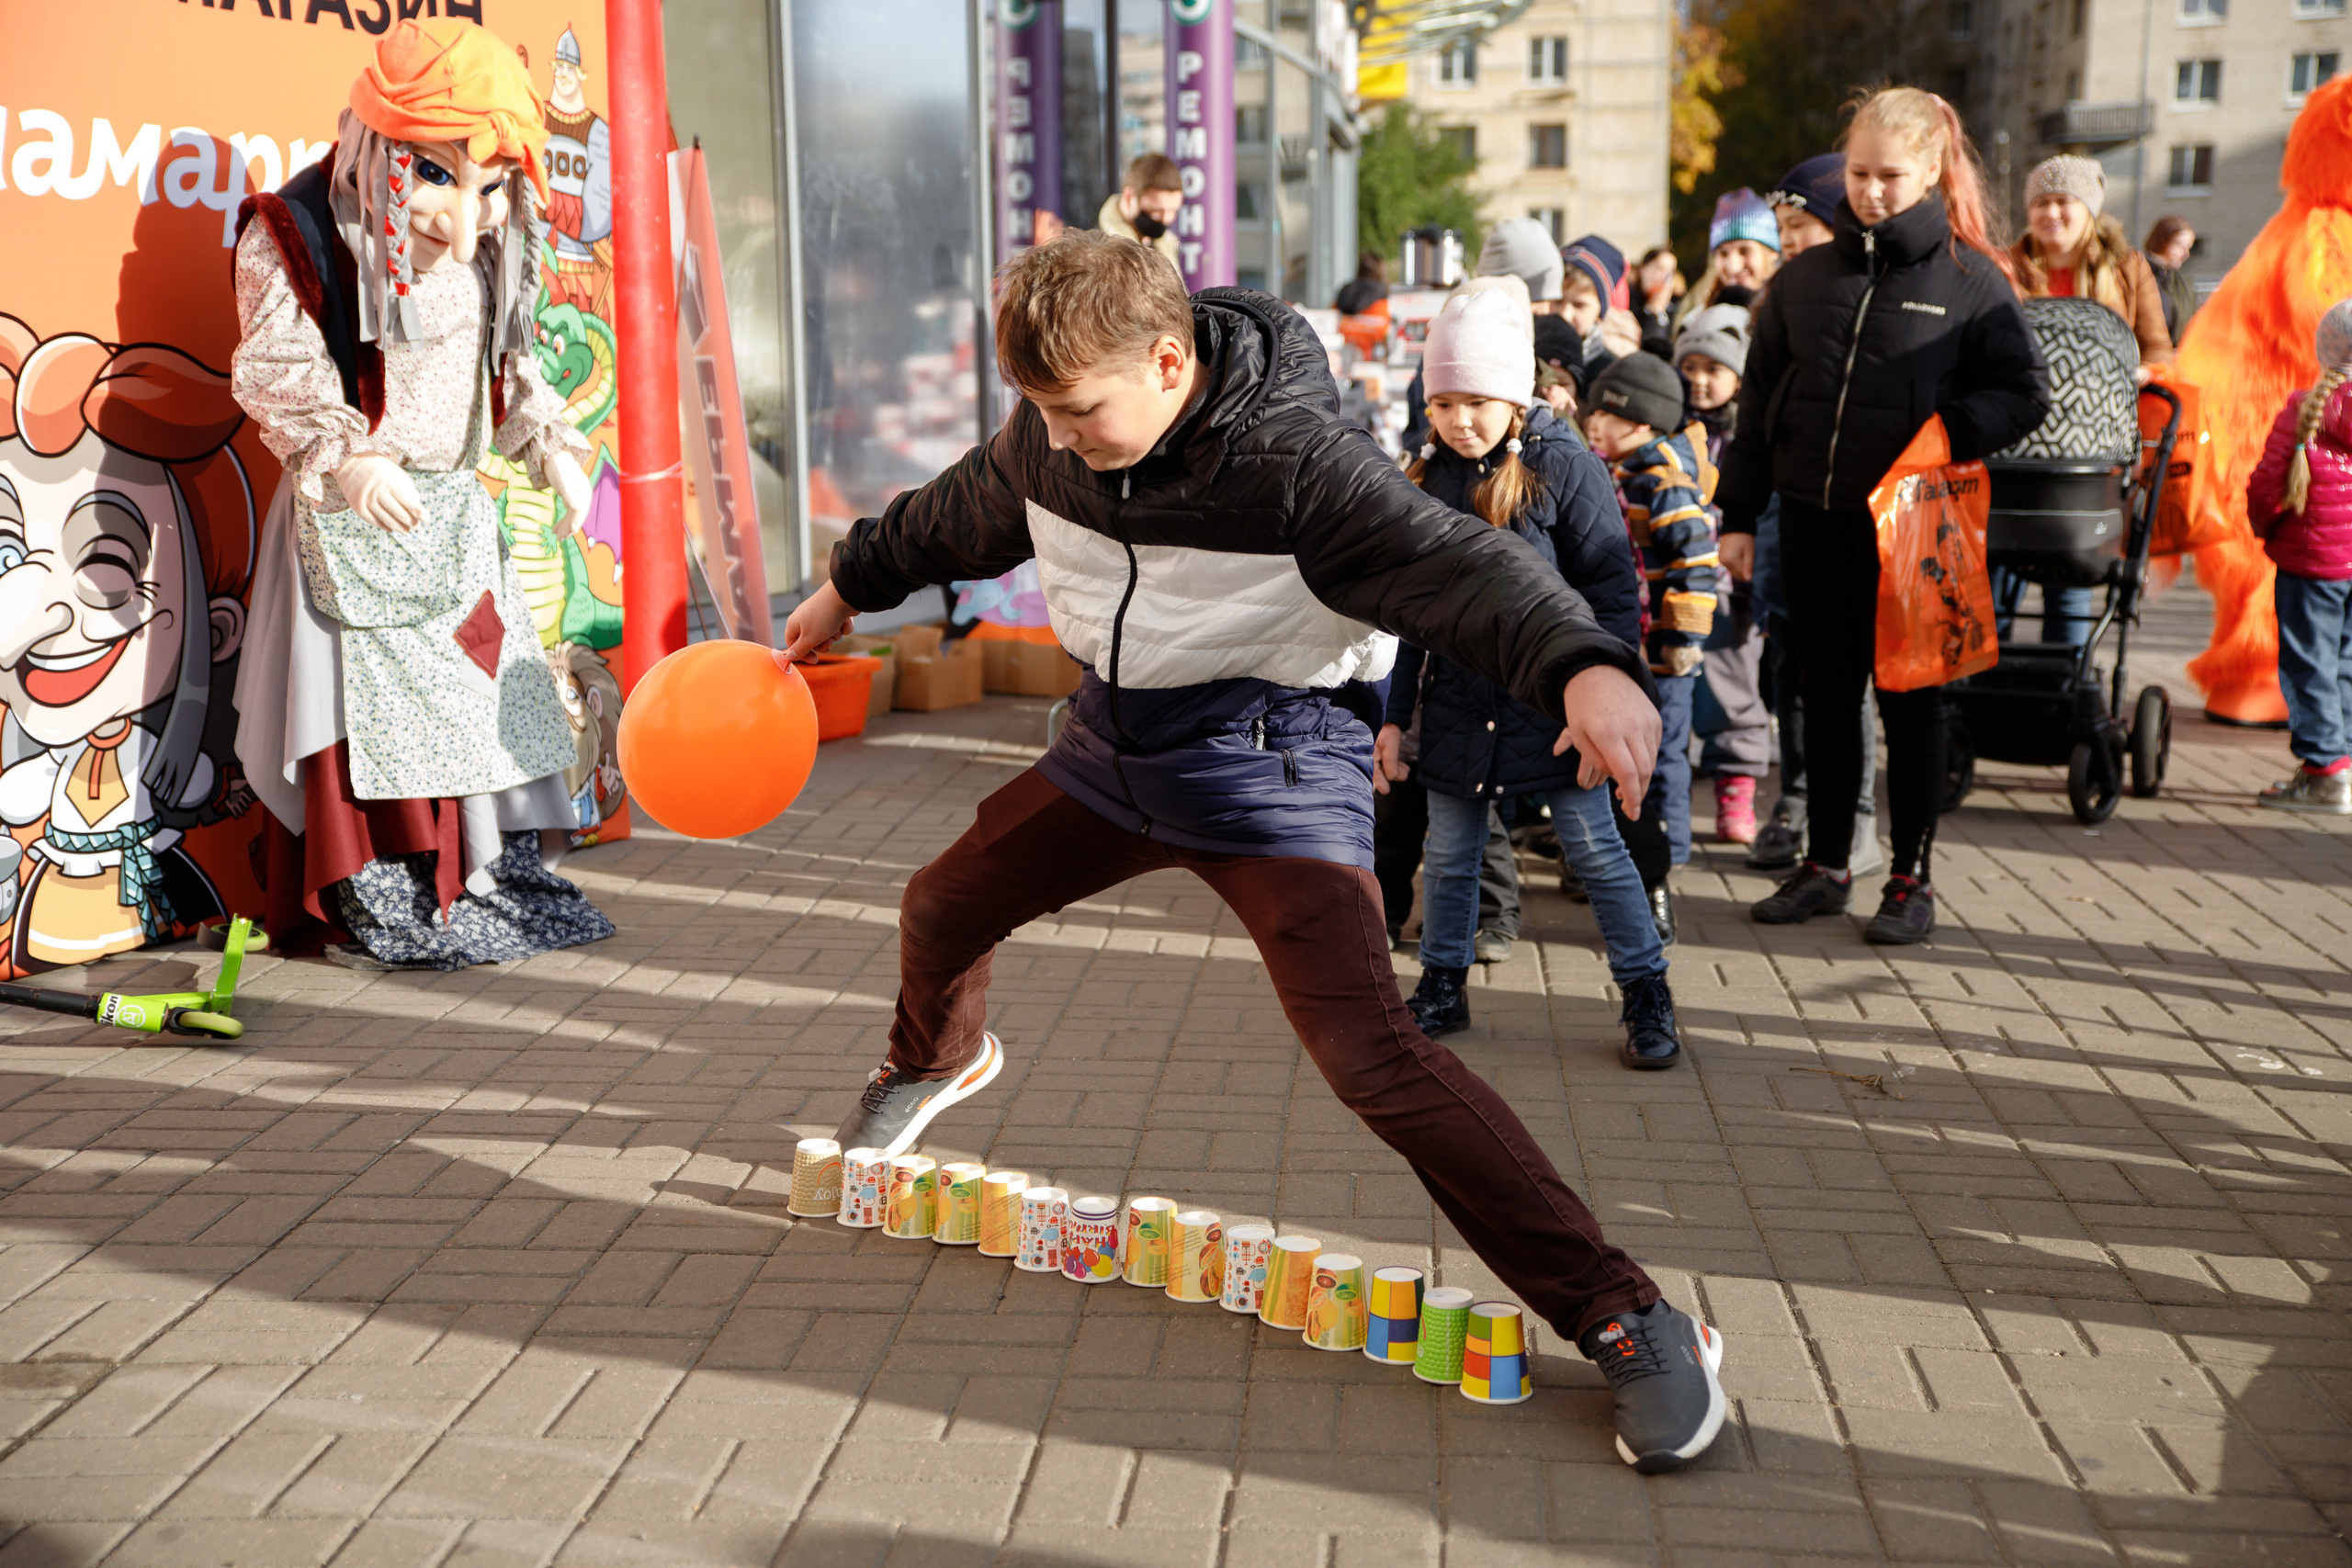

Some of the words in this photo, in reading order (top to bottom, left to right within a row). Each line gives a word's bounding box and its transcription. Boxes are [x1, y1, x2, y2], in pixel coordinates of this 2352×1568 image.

[0, 104, 334, 248] амар
[1176, 51, 1207, 275] РЕМОНТ
[905, 1097, 919, 1113] ecco
